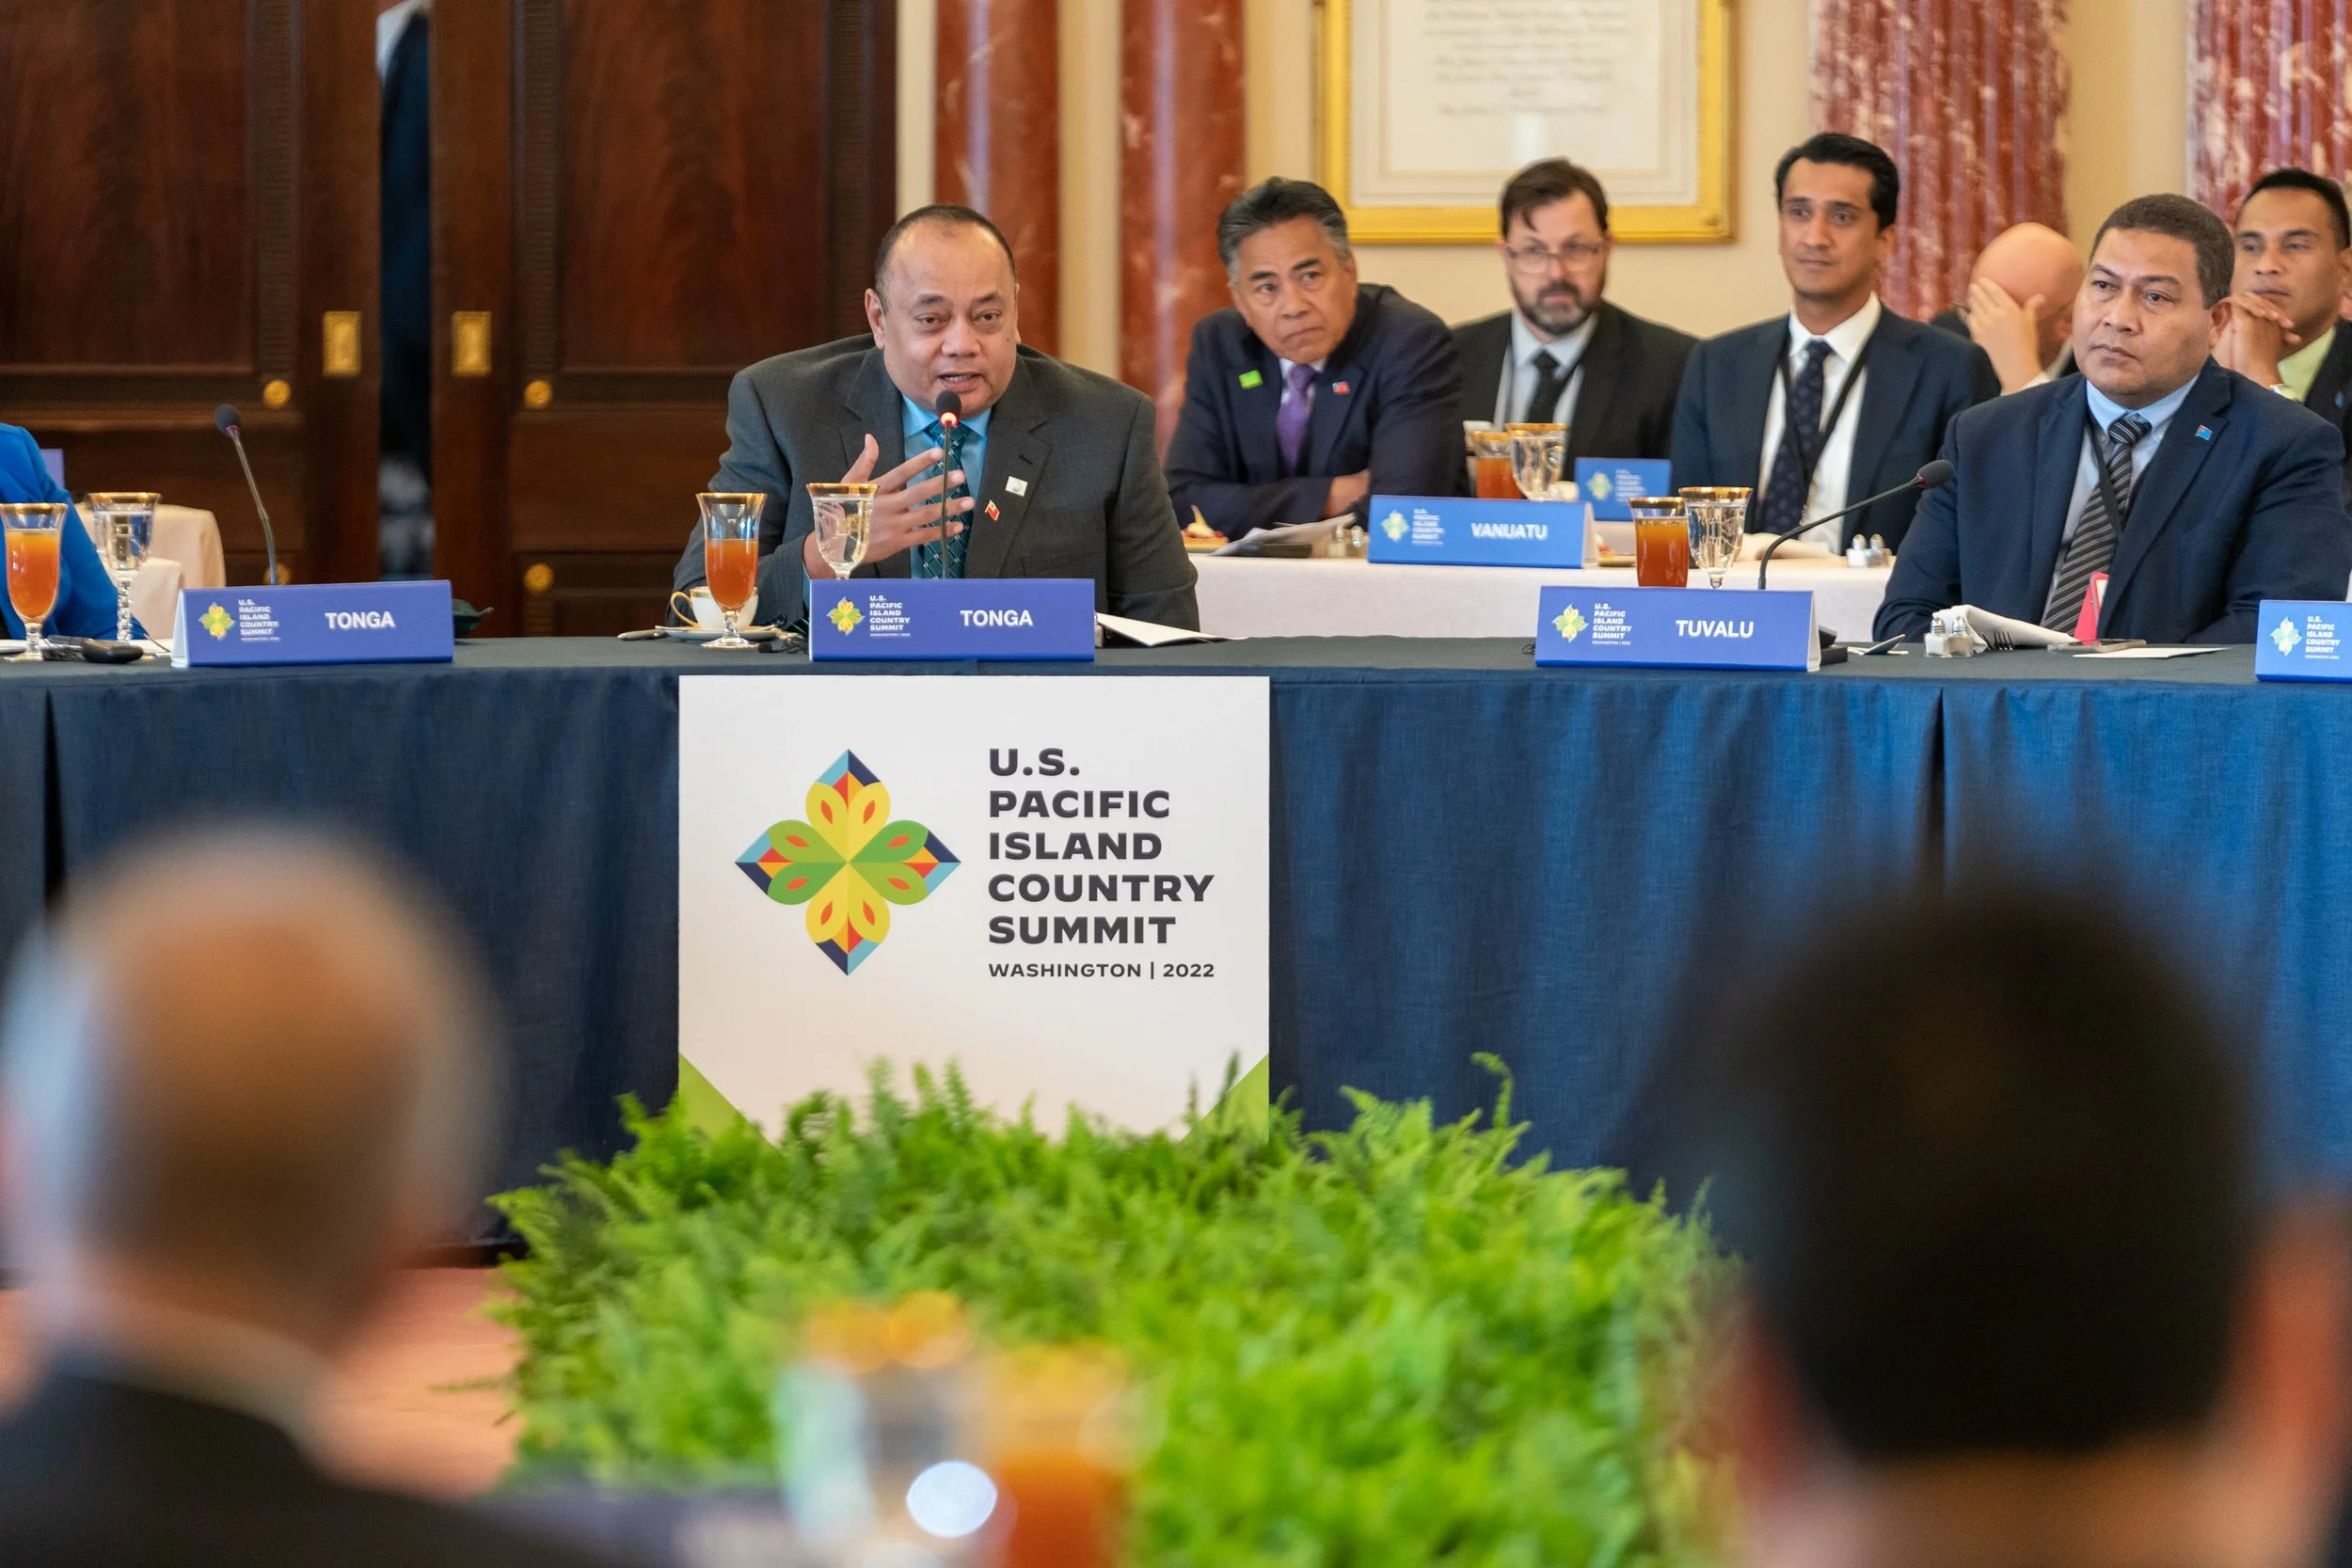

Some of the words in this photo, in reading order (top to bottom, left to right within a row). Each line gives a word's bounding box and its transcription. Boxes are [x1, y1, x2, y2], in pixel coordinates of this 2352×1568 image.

[1470, 522, 1549, 540] VANUATU
[325, 610, 396, 629] TONGA
[960, 610, 1034, 626] TONGA
[1676, 619, 1755, 638] TUVALU
[990, 748, 1080, 776] U.S.
[990, 790, 1169, 818] PACIFIC
[990, 832, 1162, 861] ISLAND
[988, 874, 1215, 902] COUNTRY
[989, 915, 1176, 944] SUMMIT
[988, 963, 1141, 977] WASHINGTON
[1163, 963, 1215, 977] 2022
